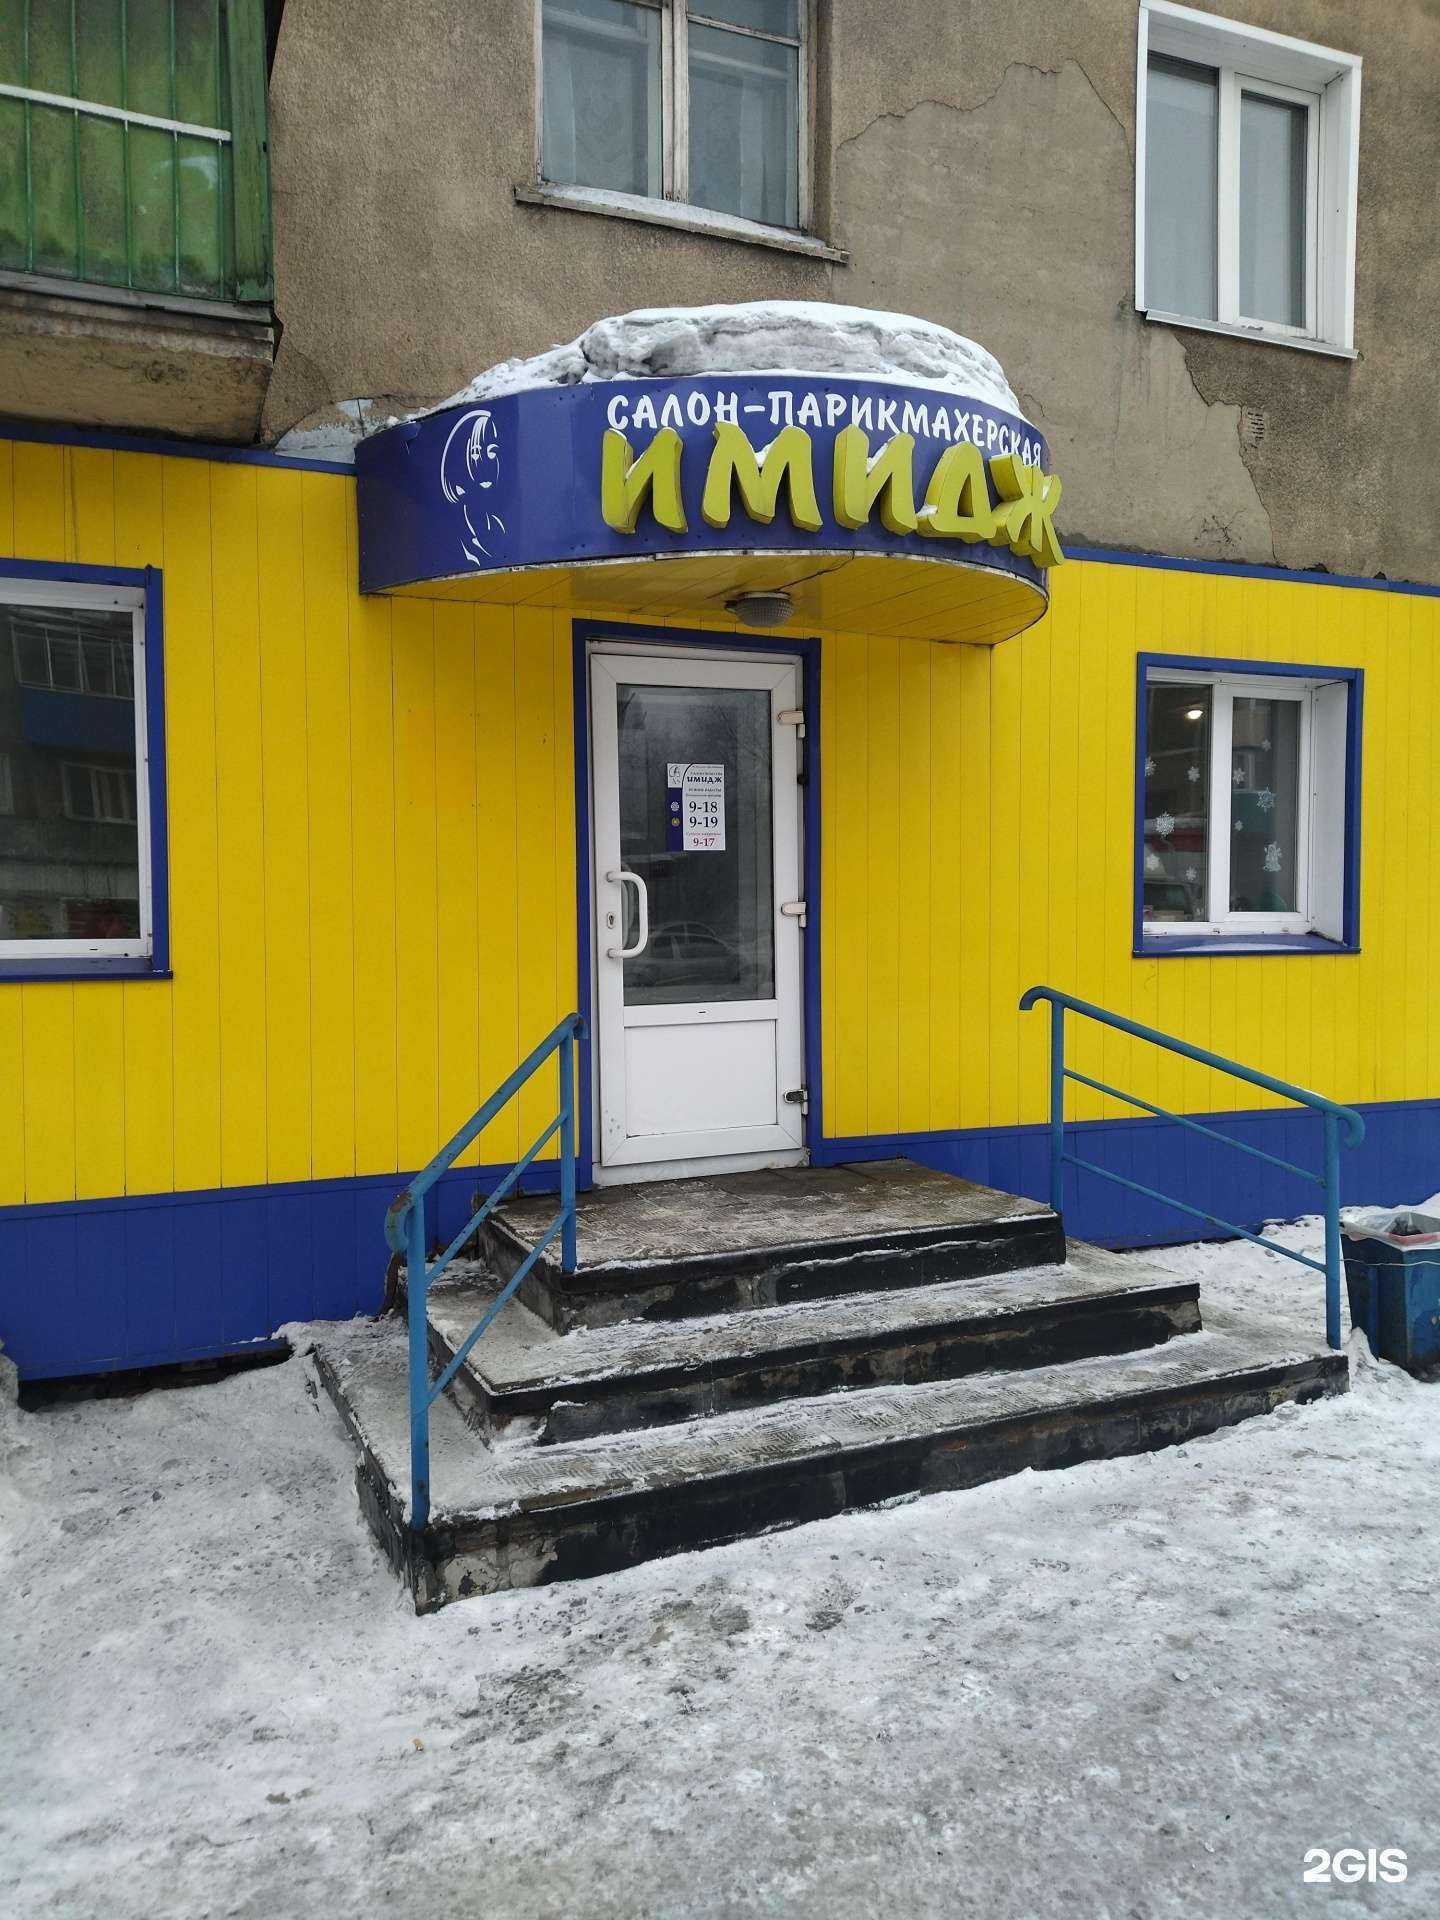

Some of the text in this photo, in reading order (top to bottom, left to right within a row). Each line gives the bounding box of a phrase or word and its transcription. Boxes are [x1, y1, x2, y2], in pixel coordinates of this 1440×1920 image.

[607, 391, 1042, 468] САЛОН-ПАРИКМАХЕРСКАЯ
[601, 421, 1064, 568] ИМИДЖ
[689, 801, 718, 813] 9-18
[689, 816, 718, 828] 9-19
[693, 837, 715, 847] 9-17
